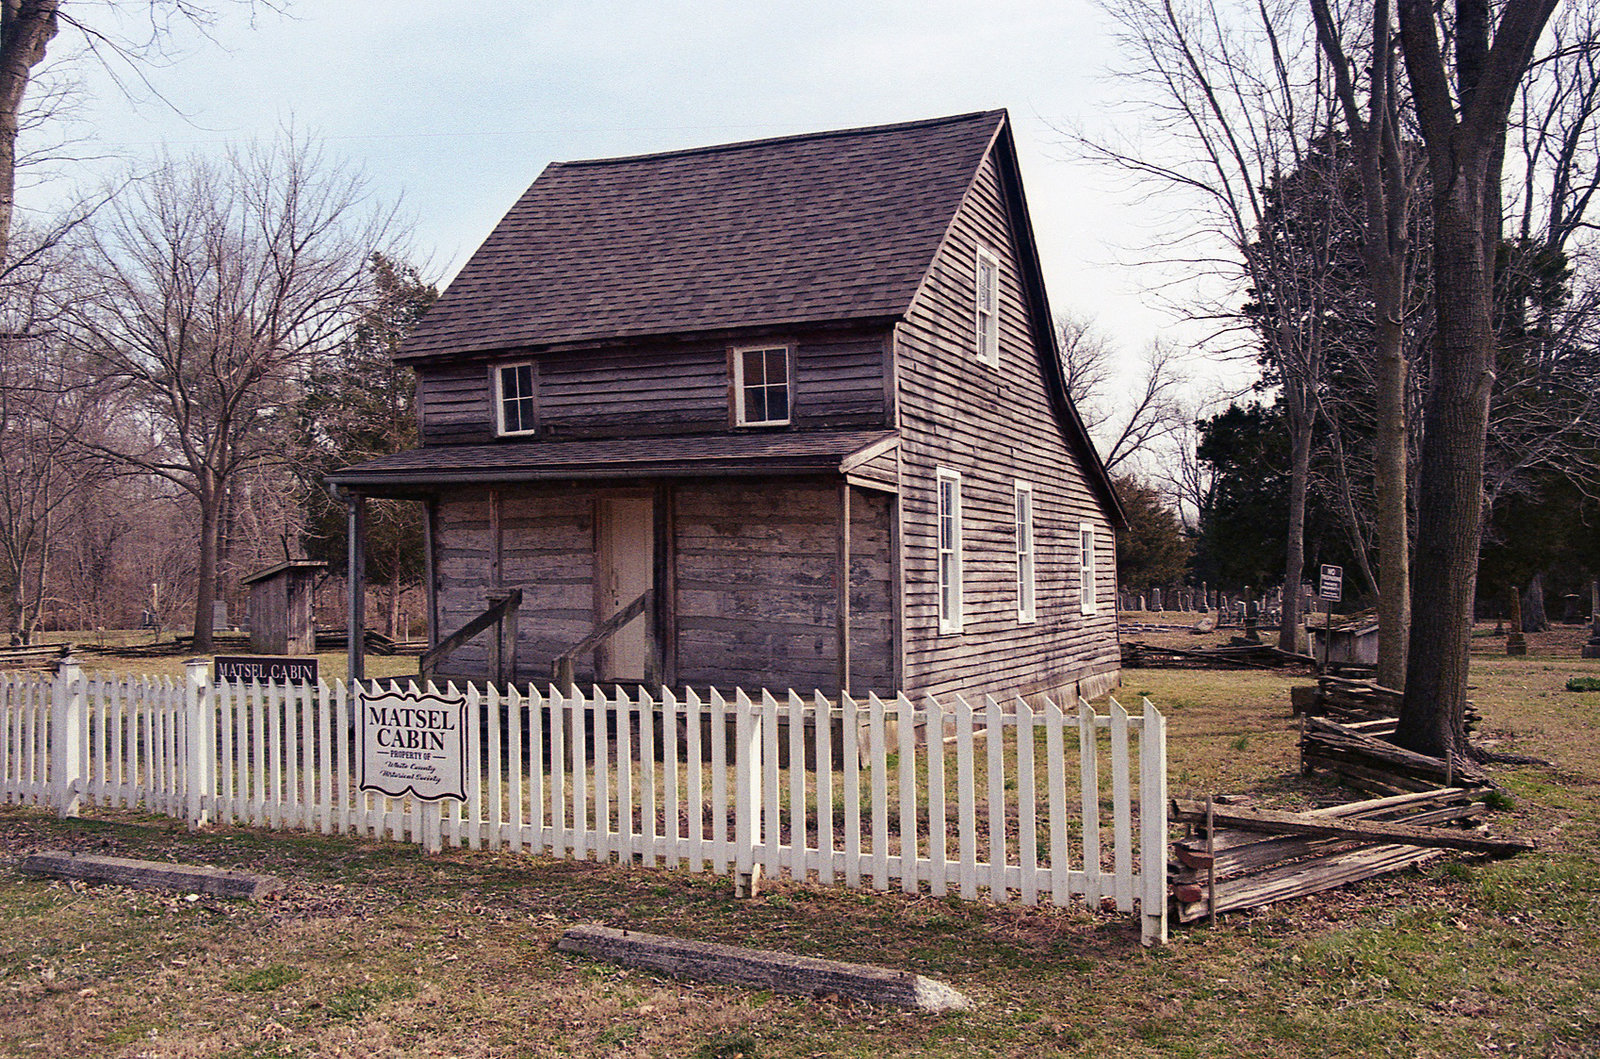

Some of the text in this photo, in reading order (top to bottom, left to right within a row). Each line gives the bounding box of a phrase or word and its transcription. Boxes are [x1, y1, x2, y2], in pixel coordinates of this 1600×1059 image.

[219, 663, 313, 679] MATSEL CABIN
[369, 706, 455, 730] MATSEL
[377, 728, 446, 750] CABIN
[390, 750, 432, 760] PROPERTY OF
[410, 763, 436, 774] County
[415, 773, 441, 785] Society
